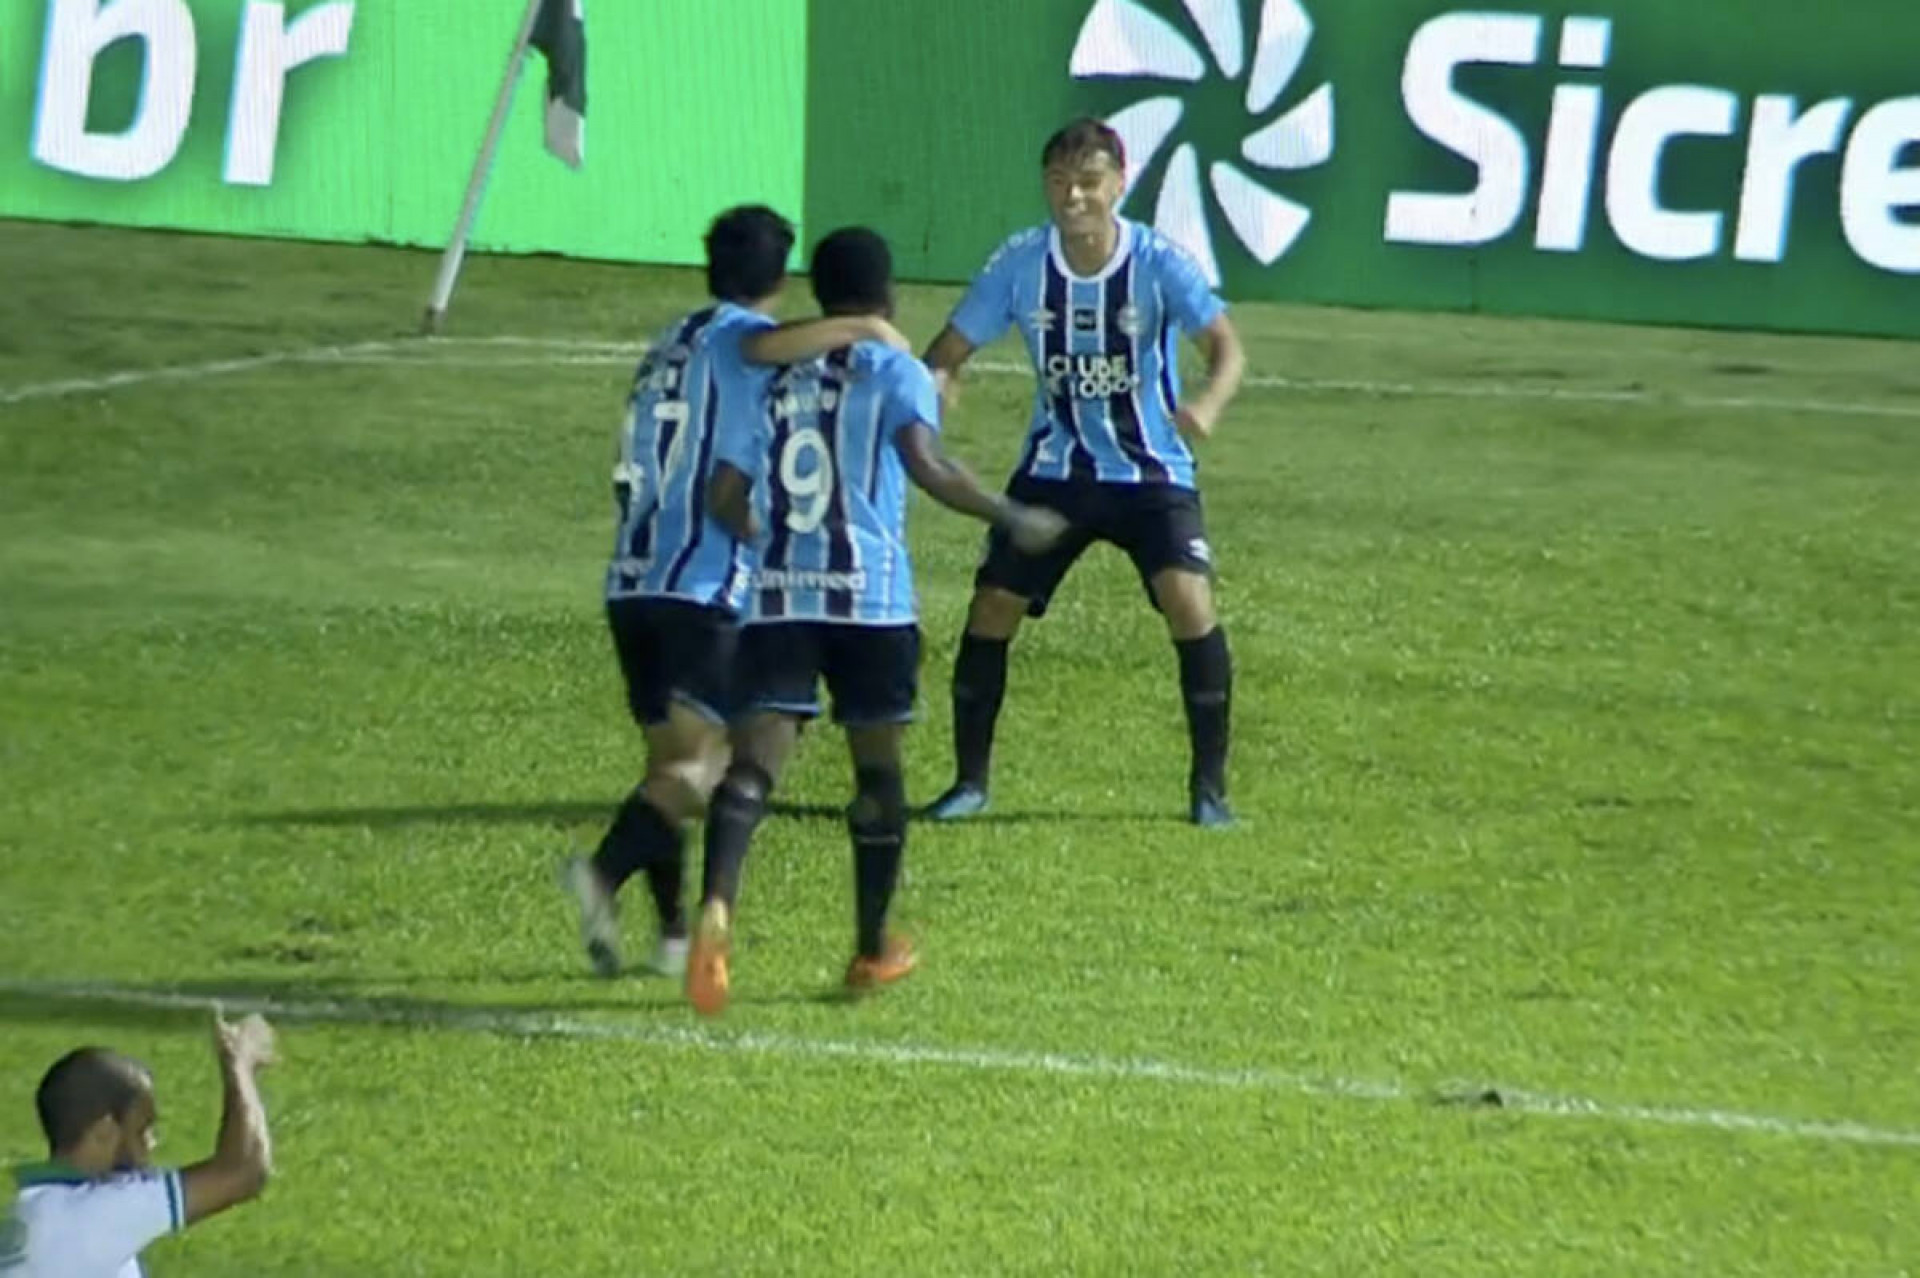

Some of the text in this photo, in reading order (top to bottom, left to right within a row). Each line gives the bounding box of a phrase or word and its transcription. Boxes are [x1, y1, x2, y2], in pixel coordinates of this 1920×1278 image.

[30, 0, 355, 186] br
[1384, 11, 1920, 274] Sicre
[779, 428, 835, 533] 9
